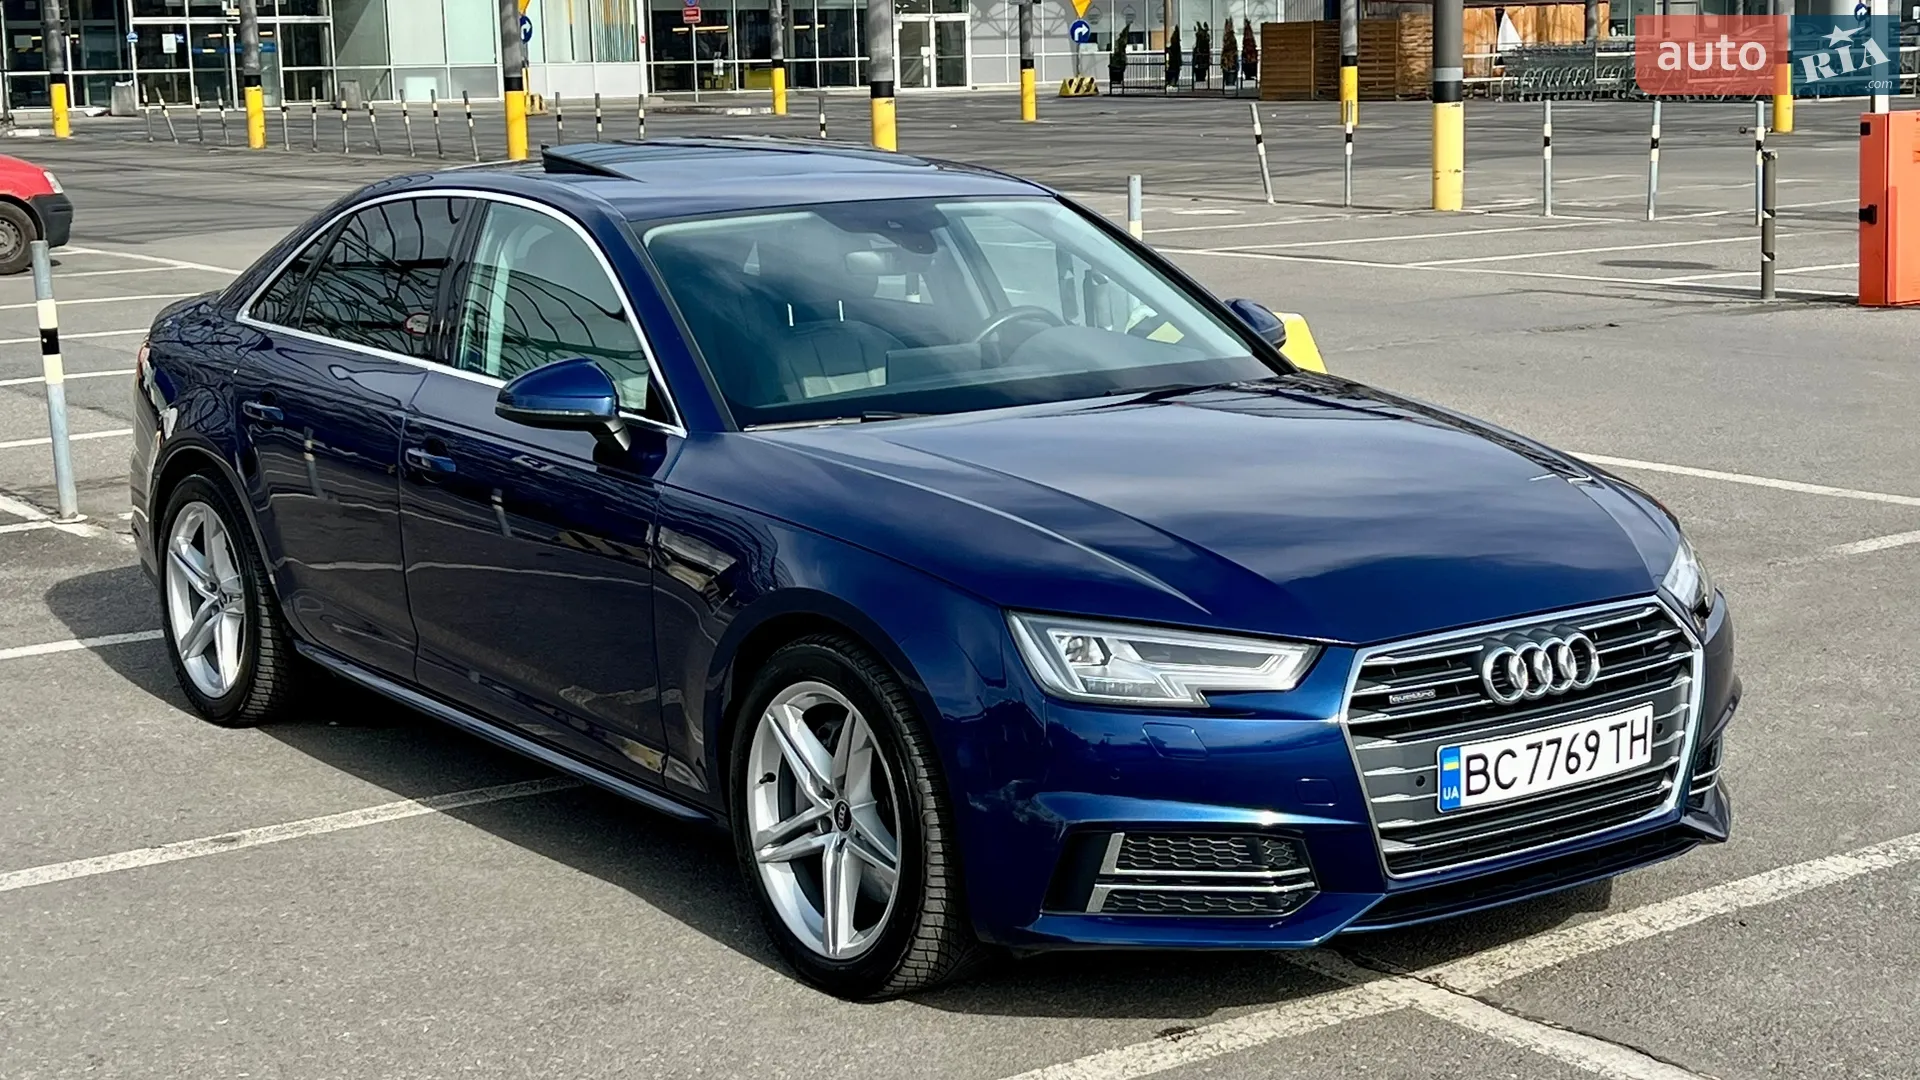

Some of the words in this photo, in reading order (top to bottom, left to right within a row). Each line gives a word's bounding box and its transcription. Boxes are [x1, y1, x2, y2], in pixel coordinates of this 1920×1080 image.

[1465, 748, 1518, 797] BC
[1525, 729, 1601, 785] 7769
[1608, 715, 1649, 764] TH
[1443, 786, 1460, 801] UA
